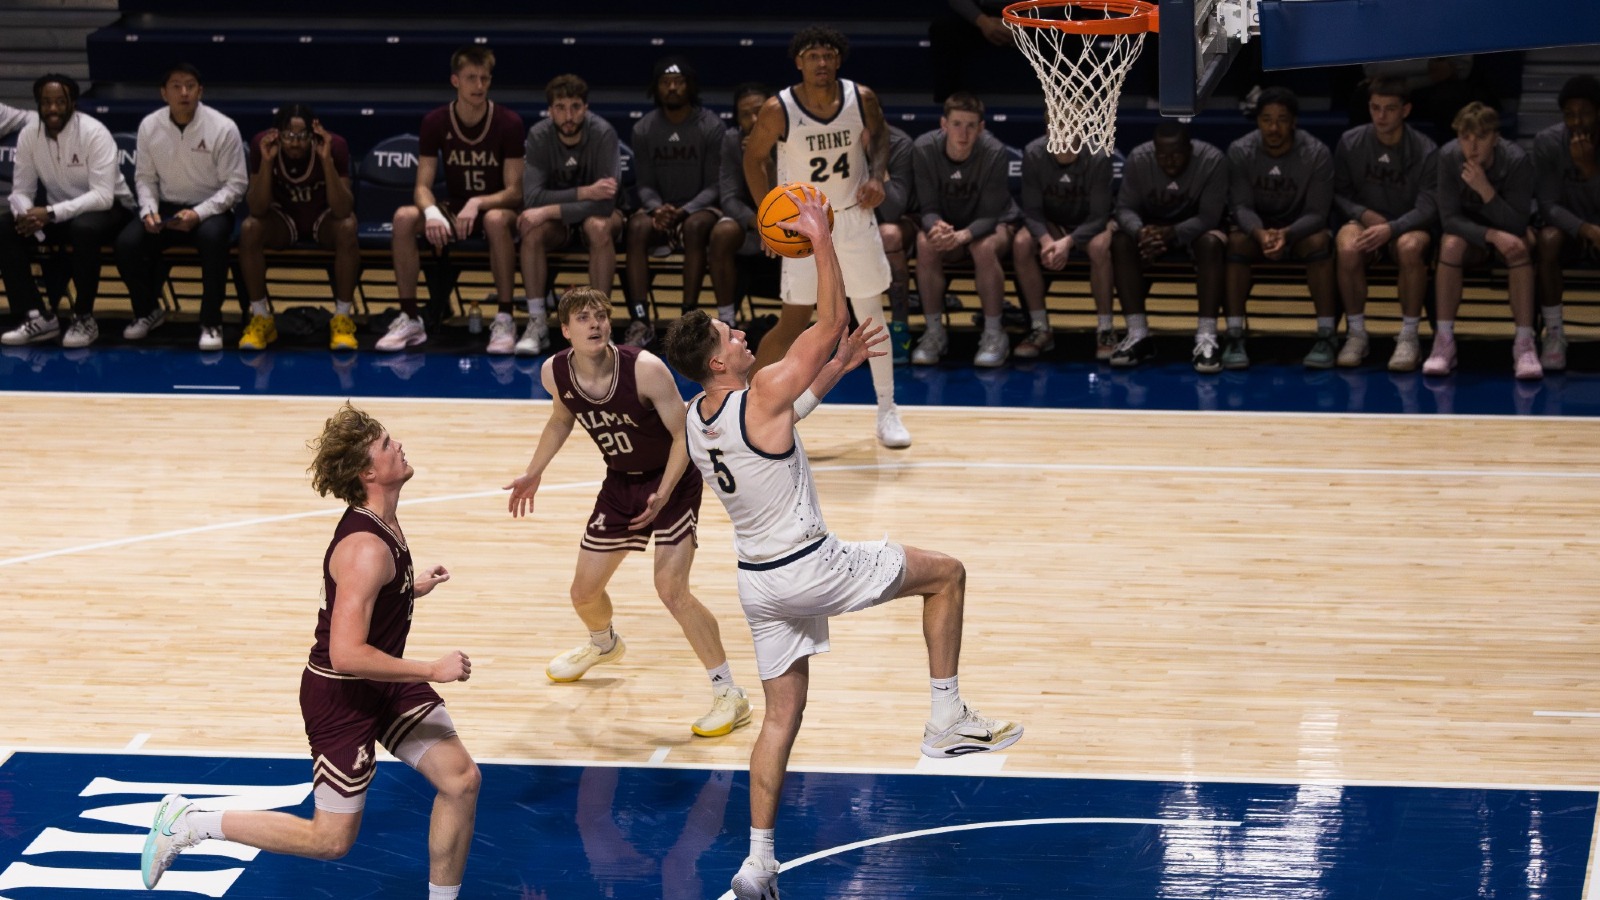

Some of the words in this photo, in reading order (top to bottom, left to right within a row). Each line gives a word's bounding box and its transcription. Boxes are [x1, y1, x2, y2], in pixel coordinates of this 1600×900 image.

[806, 130, 852, 152] TRINE
[371, 151, 418, 168] TRIN
[446, 150, 499, 168] ALMA
[655, 147, 697, 161] ALMA
[809, 152, 850, 183] 24
[464, 170, 486, 191] 15
[575, 410, 638, 430] ALMA
[597, 431, 632, 456] 20
[707, 448, 736, 494] 5
[589, 512, 606, 531] A
[352, 744, 371, 771] A
